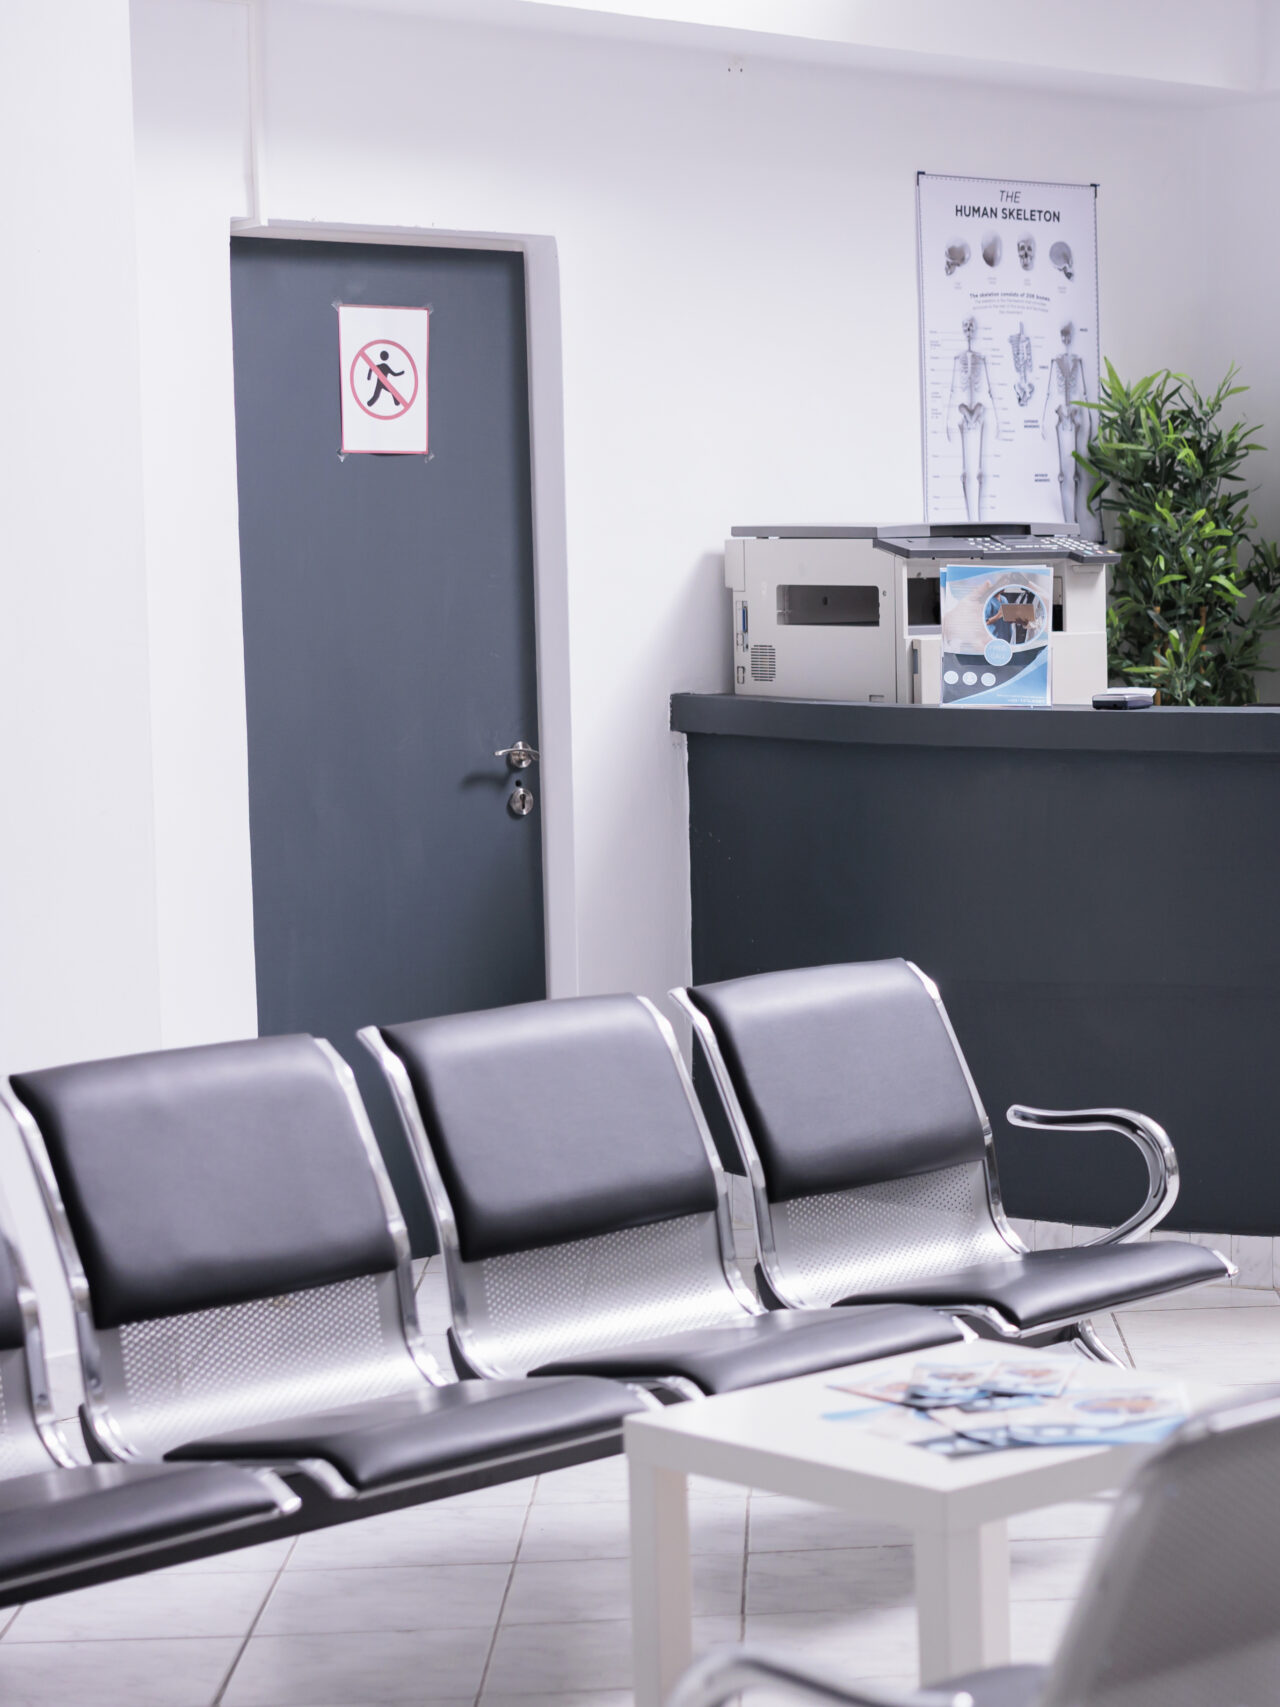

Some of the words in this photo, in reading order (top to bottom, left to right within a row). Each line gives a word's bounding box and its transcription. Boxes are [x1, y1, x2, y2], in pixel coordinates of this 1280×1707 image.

[1000, 190, 1021, 203] THE
[955, 205, 998, 219] HUMAN
[1001, 207, 1061, 222] SKELETON
